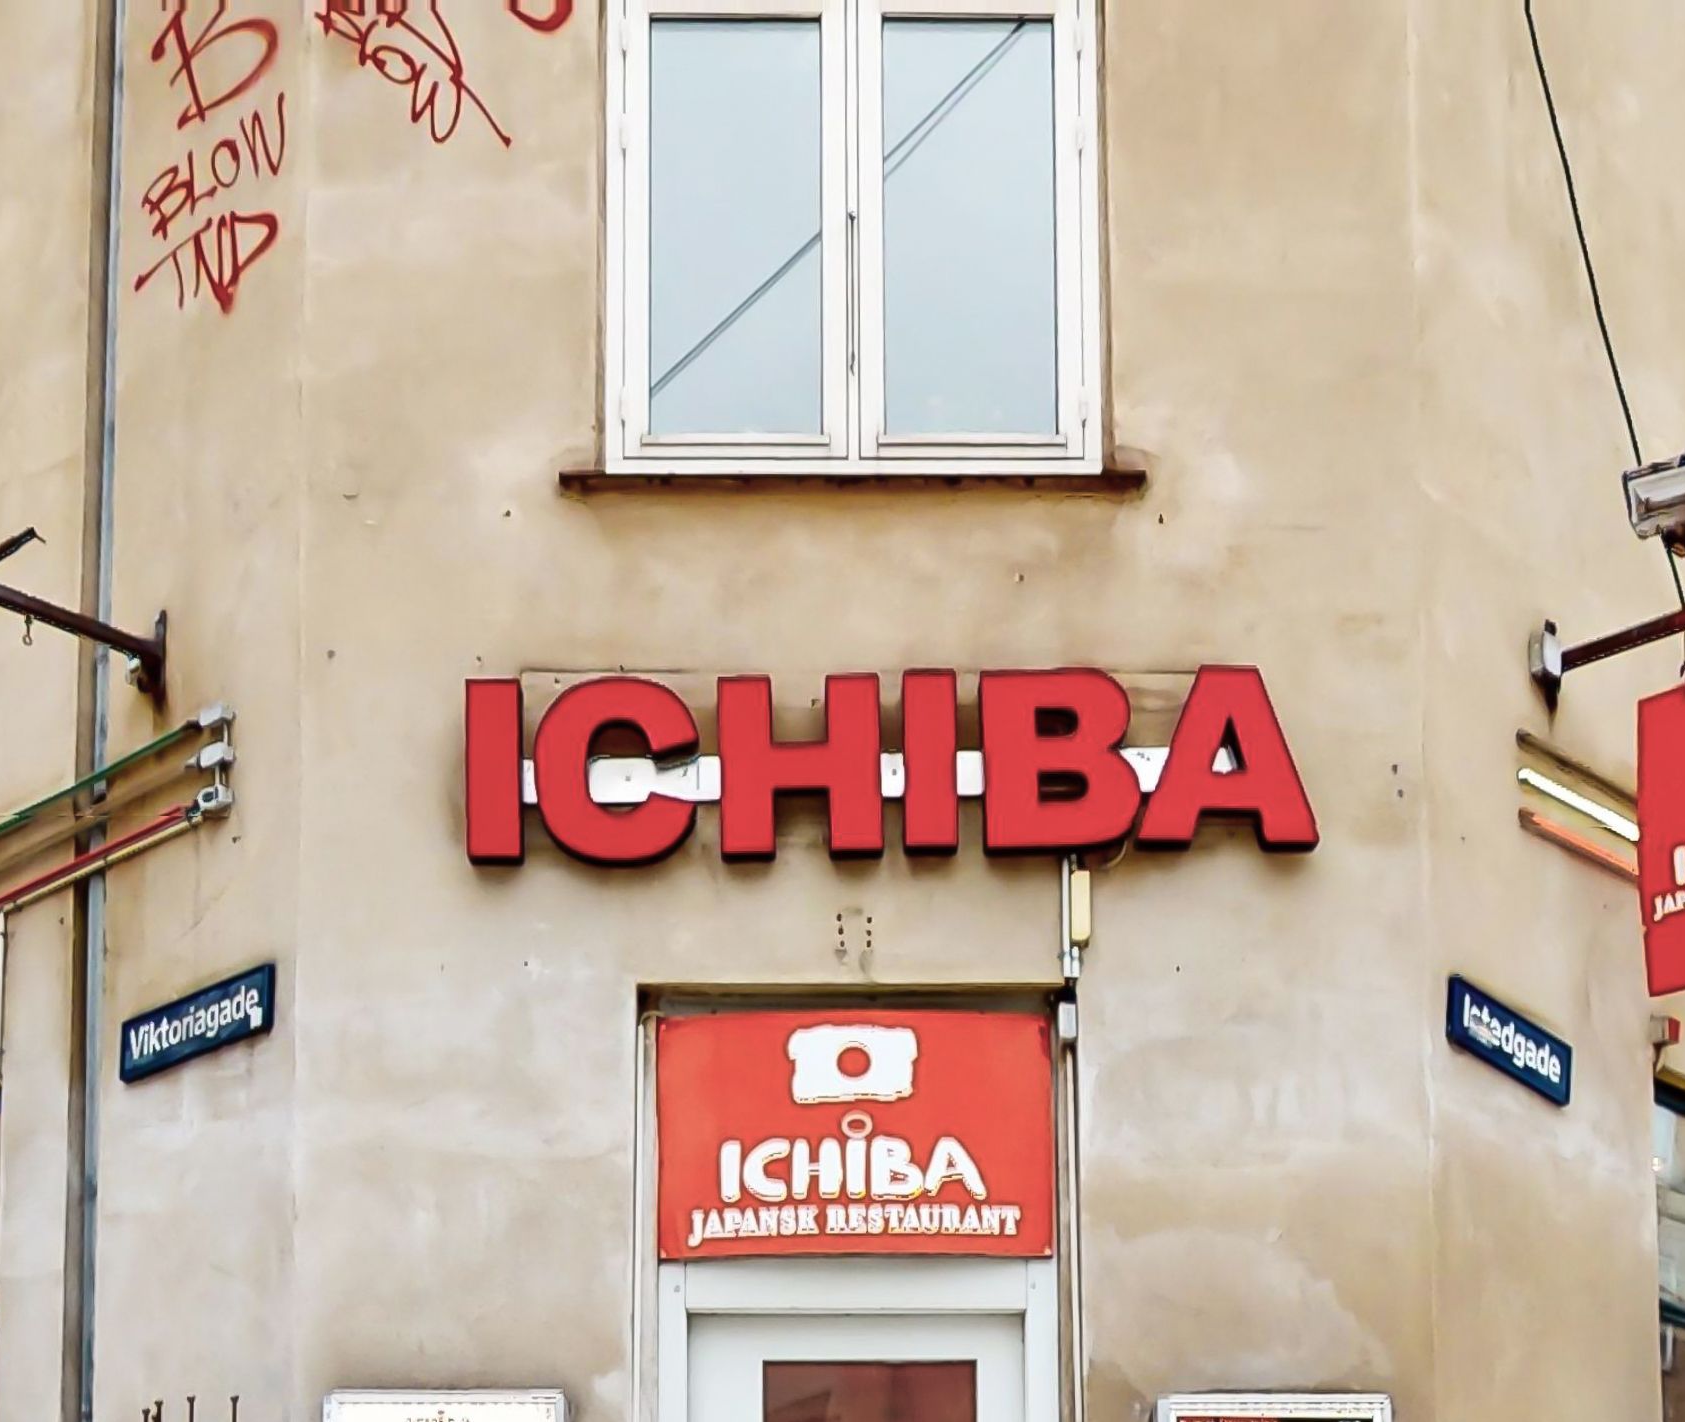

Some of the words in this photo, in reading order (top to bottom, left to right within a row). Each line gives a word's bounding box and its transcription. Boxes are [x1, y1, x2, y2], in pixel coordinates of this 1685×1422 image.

[465, 664, 1319, 865] ICHIBA
[129, 985, 260, 1060] Viktoriagade
[719, 1110, 988, 1202] ICHIBA
[687, 1203, 820, 1248] JAPANSK
[825, 1202, 1021, 1236] RESTAURANT
